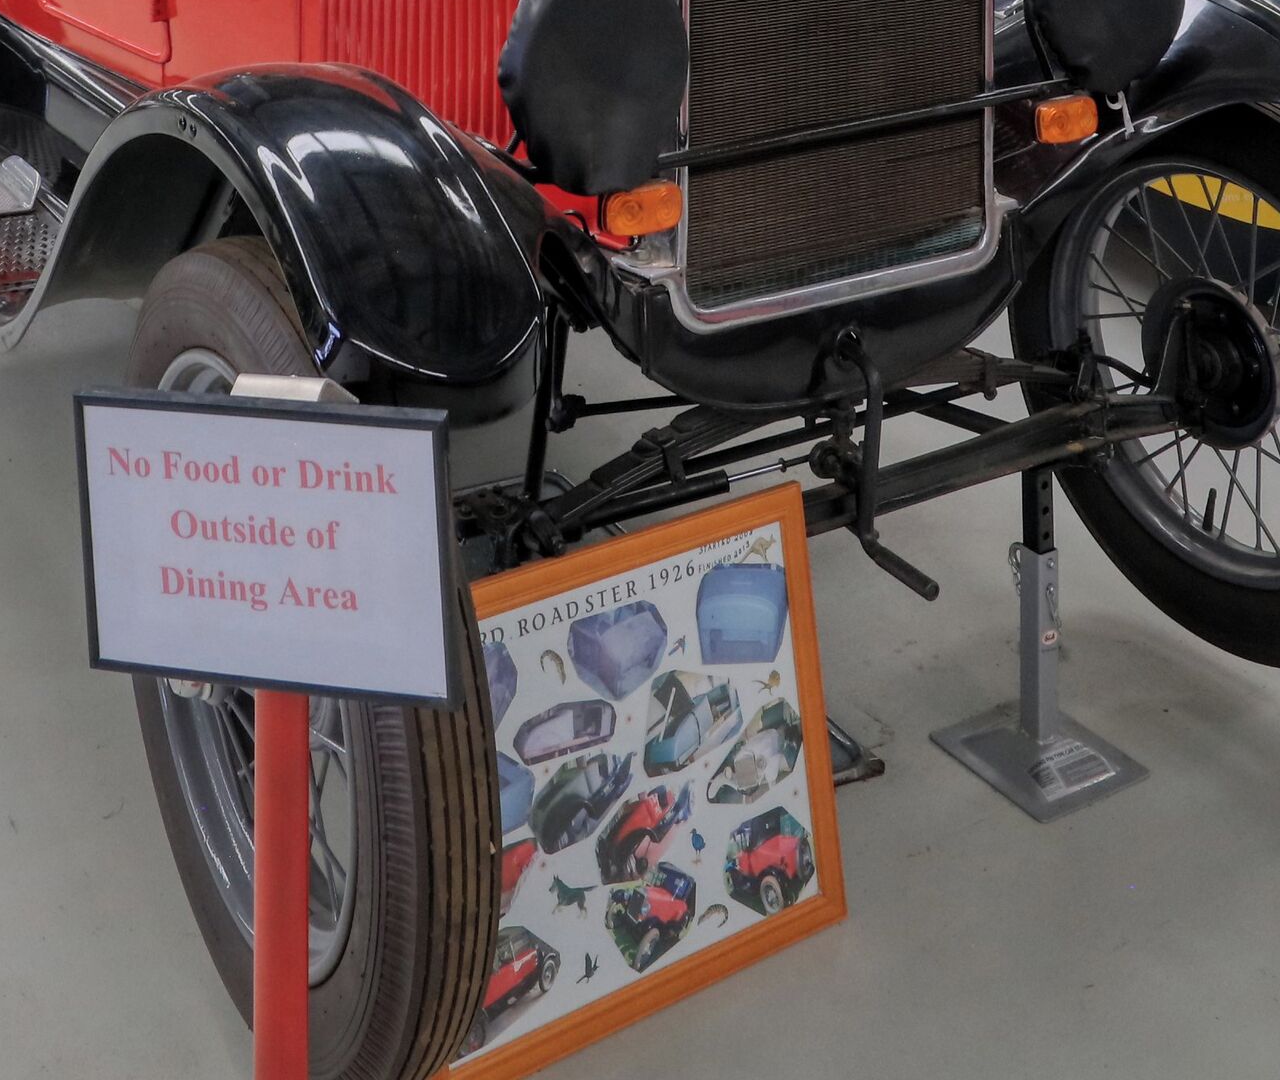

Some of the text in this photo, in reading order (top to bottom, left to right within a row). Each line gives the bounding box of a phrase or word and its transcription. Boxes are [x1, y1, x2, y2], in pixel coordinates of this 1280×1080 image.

[107, 446, 399, 495] No Food or Drink
[170, 508, 341, 550] Outside of
[159, 566, 359, 612] Dining Area
[518, 579, 638, 638] ROADSTER
[648, 559, 696, 591] 1926
